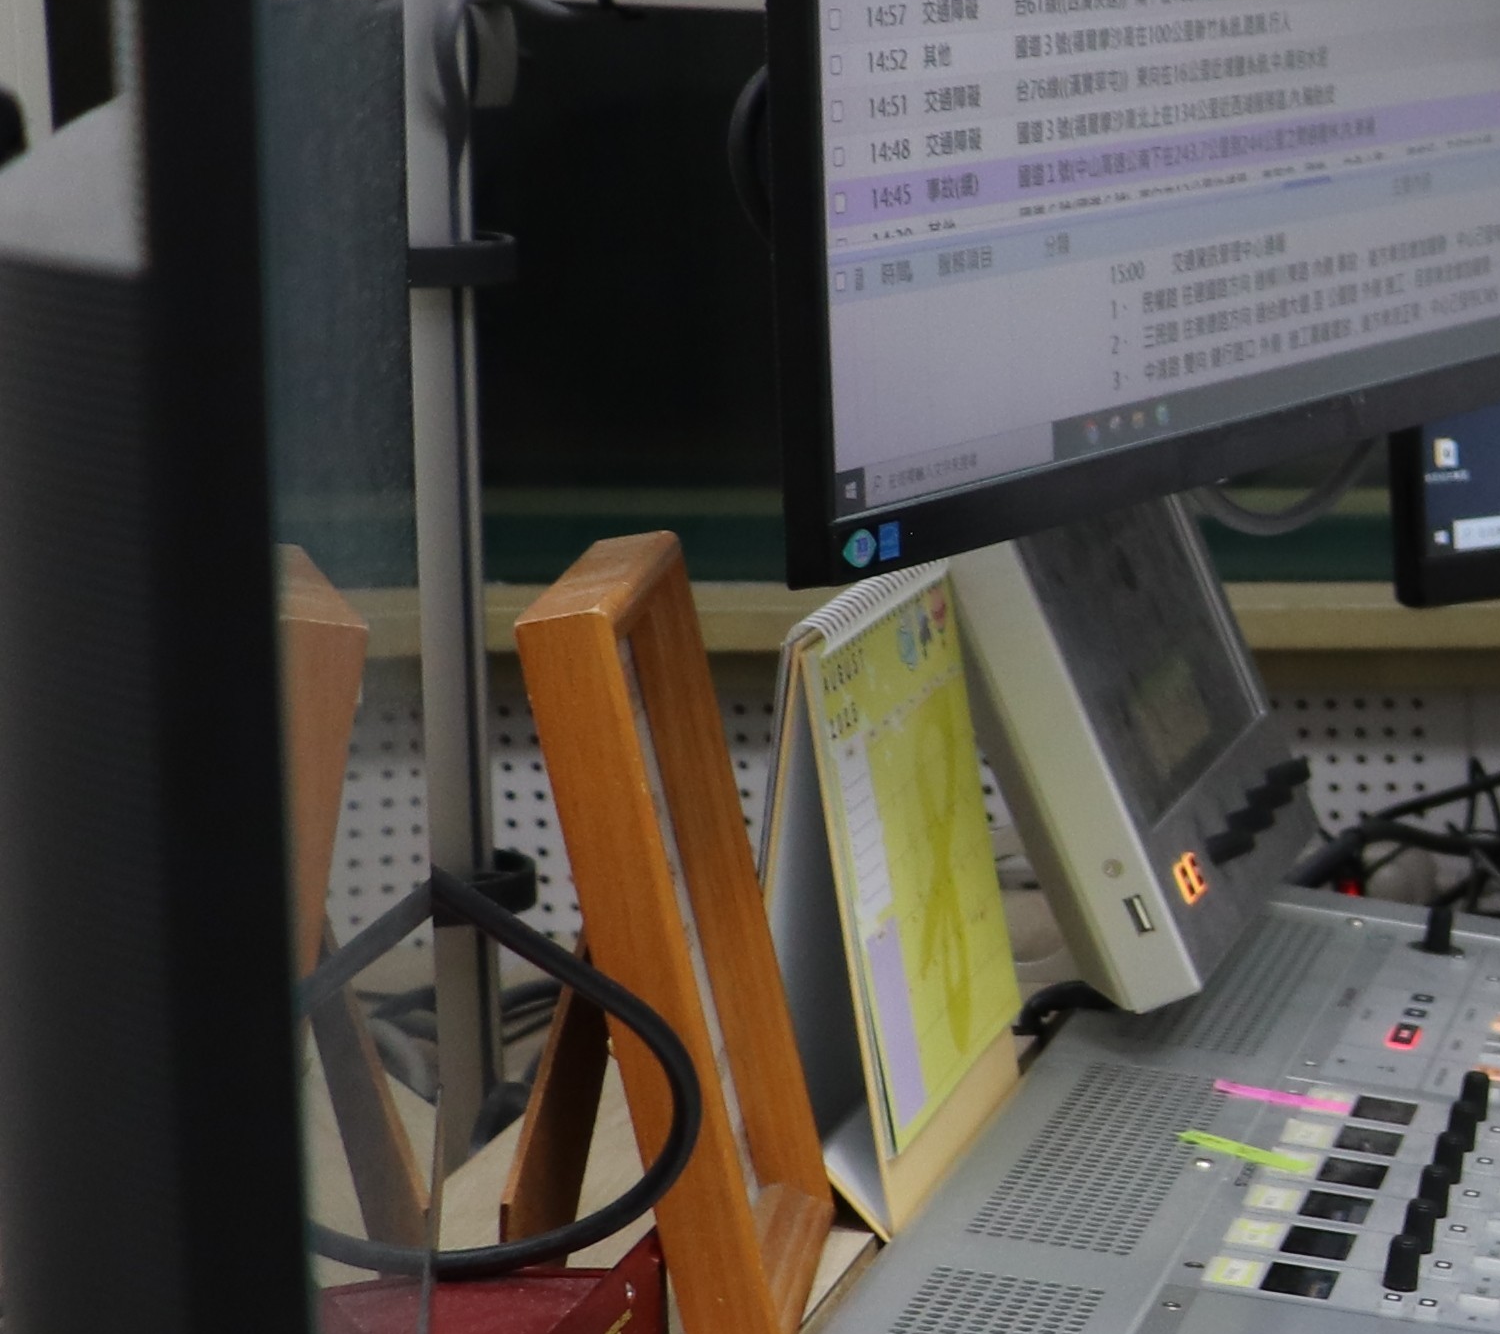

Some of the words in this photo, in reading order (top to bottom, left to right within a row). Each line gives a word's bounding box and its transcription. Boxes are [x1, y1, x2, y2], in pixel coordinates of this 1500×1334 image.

[866, 2, 907, 29] 14:57
[868, 46, 908, 73] 14:52
[923, 41, 952, 69] 其他
[869, 92, 909, 120] 14:51
[870, 136, 910, 164] 14:48
[871, 181, 911, 209] 14:45
